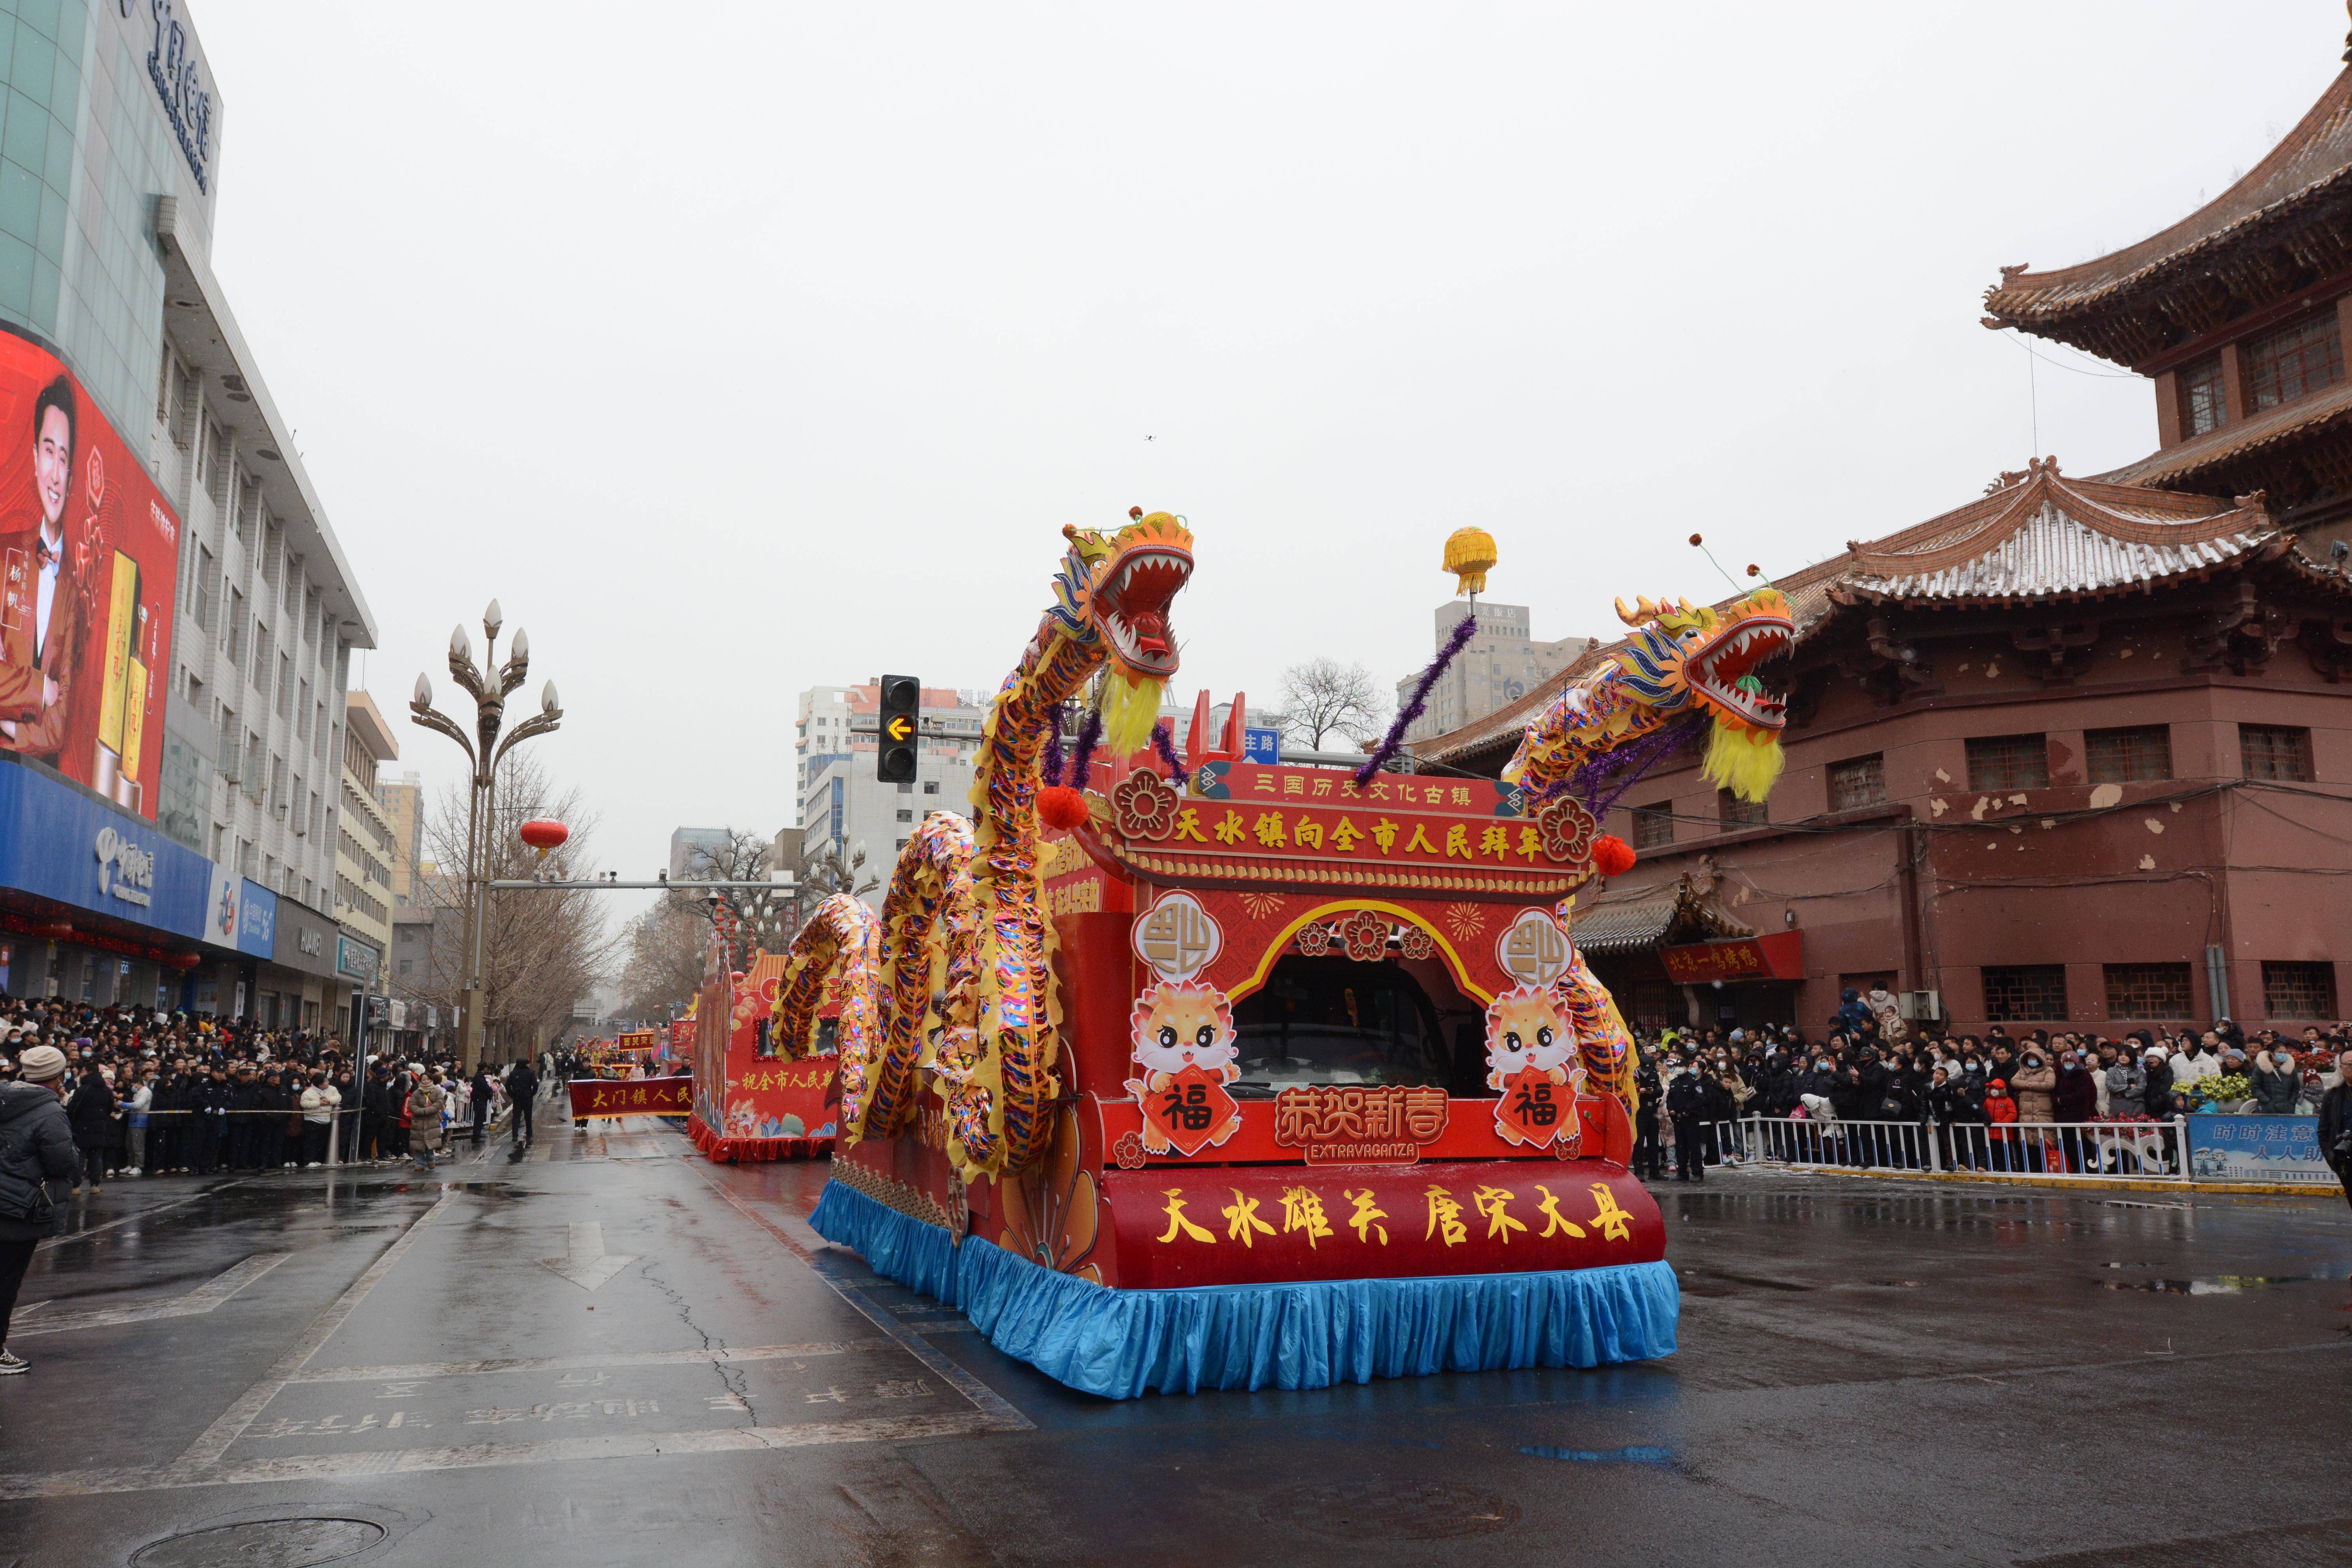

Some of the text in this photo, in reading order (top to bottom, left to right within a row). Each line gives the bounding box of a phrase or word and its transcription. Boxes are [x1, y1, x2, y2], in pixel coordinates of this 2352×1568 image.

[7, 564, 22, 609] 杨帆
[1245, 734, 1273, 751] 主路
[1254, 772, 1472, 806] 三国历史文化古镇
[1174, 808, 1543, 863] 天水镇向全市人民拜年
[301, 927, 321, 957] HUAWEI
[592, 1086, 692, 1108] 大门镇人民
[742, 1070, 834, 1092] 祝全市人民新
[1162, 1085, 1213, 1131] 福
[1281, 1091, 1445, 1140] 恭贺新春
[1514, 1083, 1557, 1127] 福
[2213, 1124, 2315, 1142] 时时注意
[1310, 1143, 1415, 1159] EXTRAVAGANZA
[1156, 1181, 1635, 1251] 天水雄关 唐宋大县
